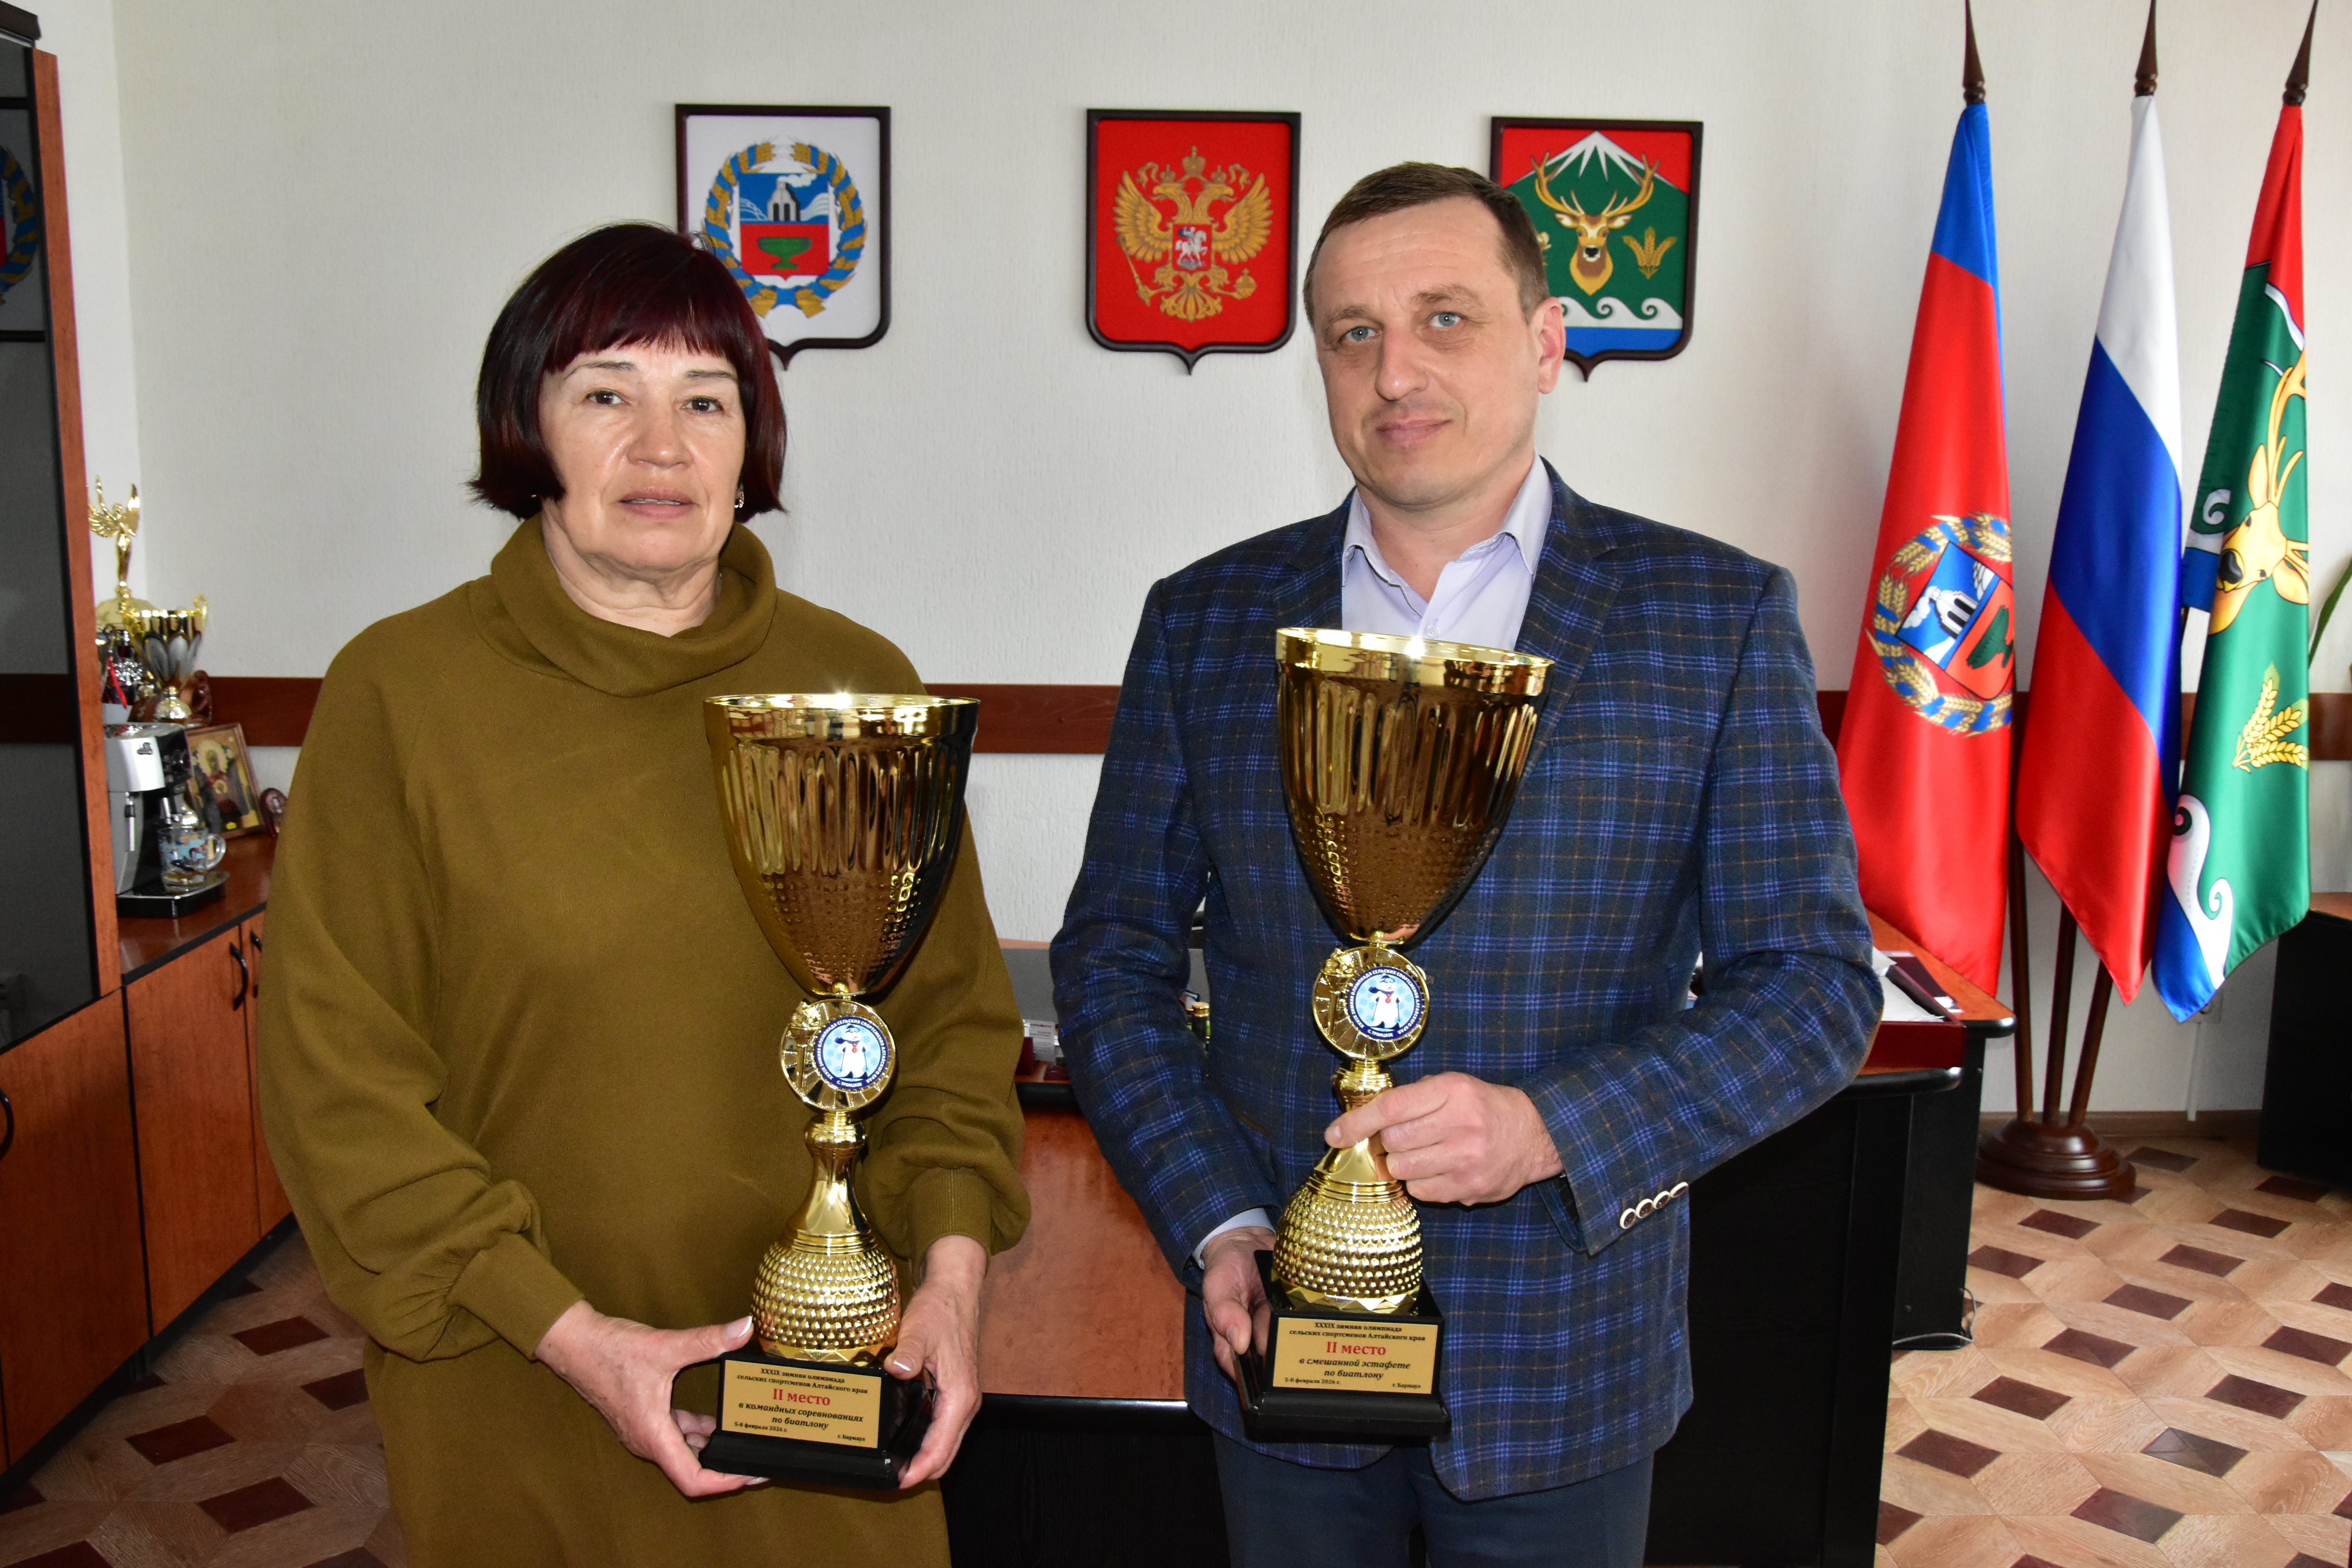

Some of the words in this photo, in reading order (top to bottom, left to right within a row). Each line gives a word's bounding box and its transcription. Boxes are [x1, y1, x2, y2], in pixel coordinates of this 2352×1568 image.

[1351, 973, 1372, 995] ОЛИМПИАДА
[1396, 972, 1419, 999] СПОРТСМЕНОВ
[1408, 999, 1420, 1027] АЛТАЙСКОГО
[818, 1023, 837, 1047] ОЛИМПИАДА
[861, 1021, 884, 1047] СПОРТСМЕНОВ
[1398, 1025, 1409, 1034] КРАЯ
[876, 1047, 886, 1074] АЛТАЙСКОГО
[866, 1073, 877, 1083] КРАЯ
[1326, 1341, 1338, 1353] II
[1341, 1345, 1387, 1356] место
[1307, 1357, 1360, 1367] смешанной
[1362, 1361, 1410, 1370] эстафете
[737, 1374, 767, 1382] сельских
[768, 1378, 811, 1388] спортсменов
[812, 1382, 850, 1392] Алтайского
[808, 1374, 845, 1383] олимпиада
[1337, 1369, 1384, 1380] биатлону
[773, 1388, 783, 1400] II
[787, 1393, 831, 1406] место
[746, 1403, 797, 1415] командных
[798, 1409, 864, 1422] соревнованиях
[784, 1417, 829, 1430] биатлону
[842, 1434, 866, 1442] Барнаул
